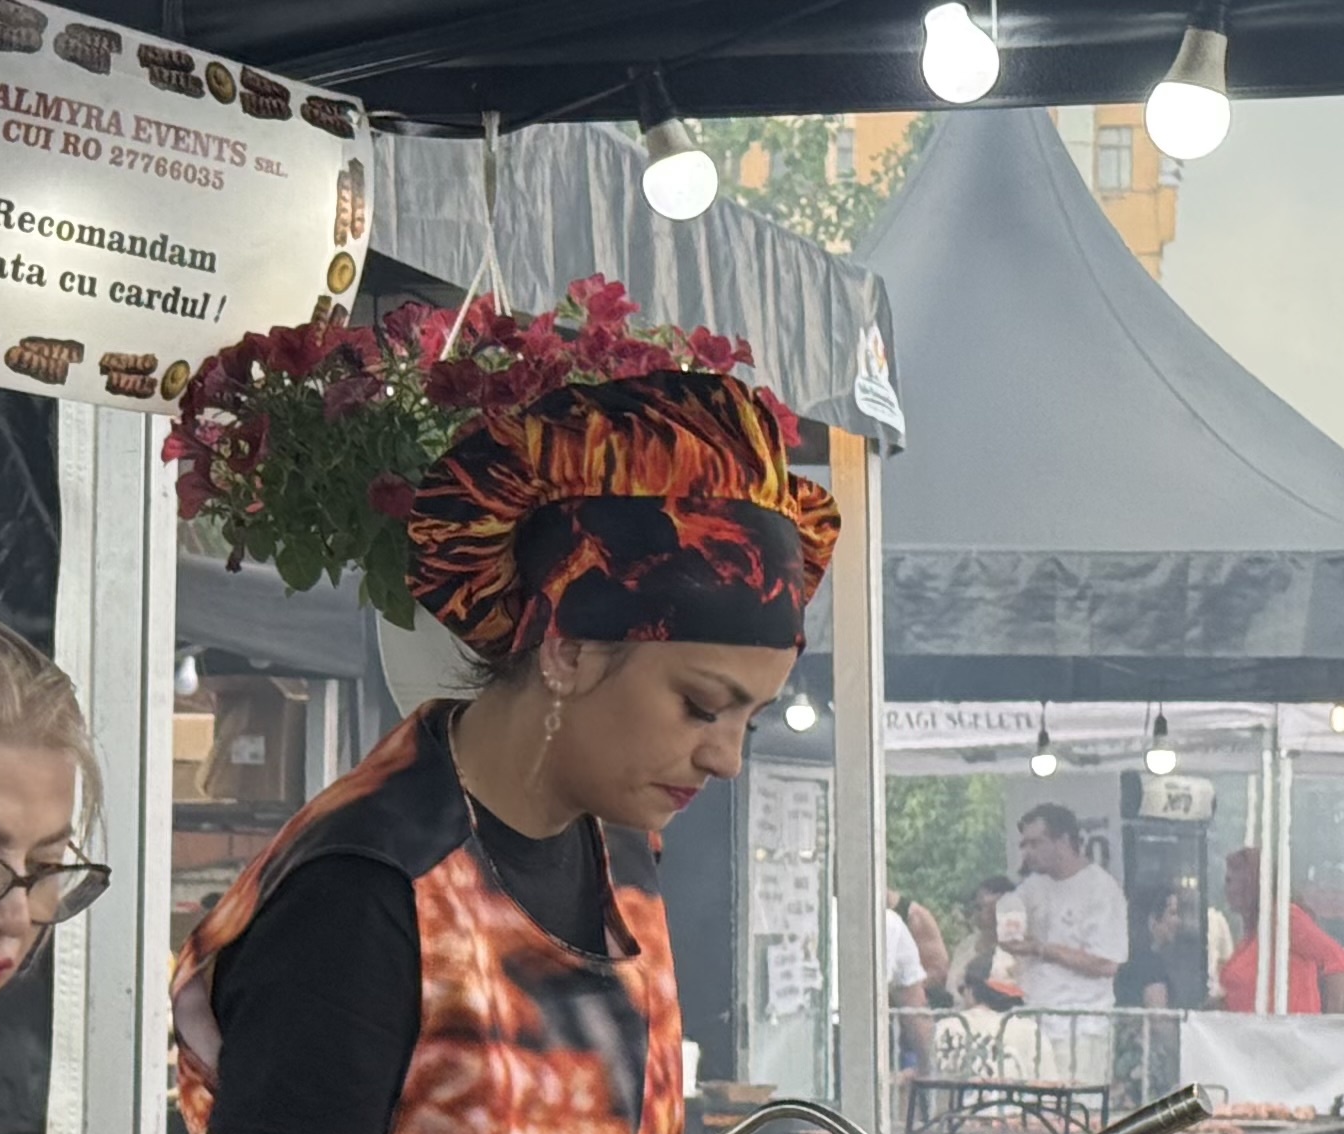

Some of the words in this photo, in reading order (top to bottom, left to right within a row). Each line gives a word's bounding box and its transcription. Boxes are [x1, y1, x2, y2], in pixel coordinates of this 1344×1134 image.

[2, 119, 54, 151] CUI
[59, 131, 102, 161] RO
[109, 146, 225, 191] 27766035
[131, 114, 248, 167] EVENTS
[59, 271, 97, 298] cu
